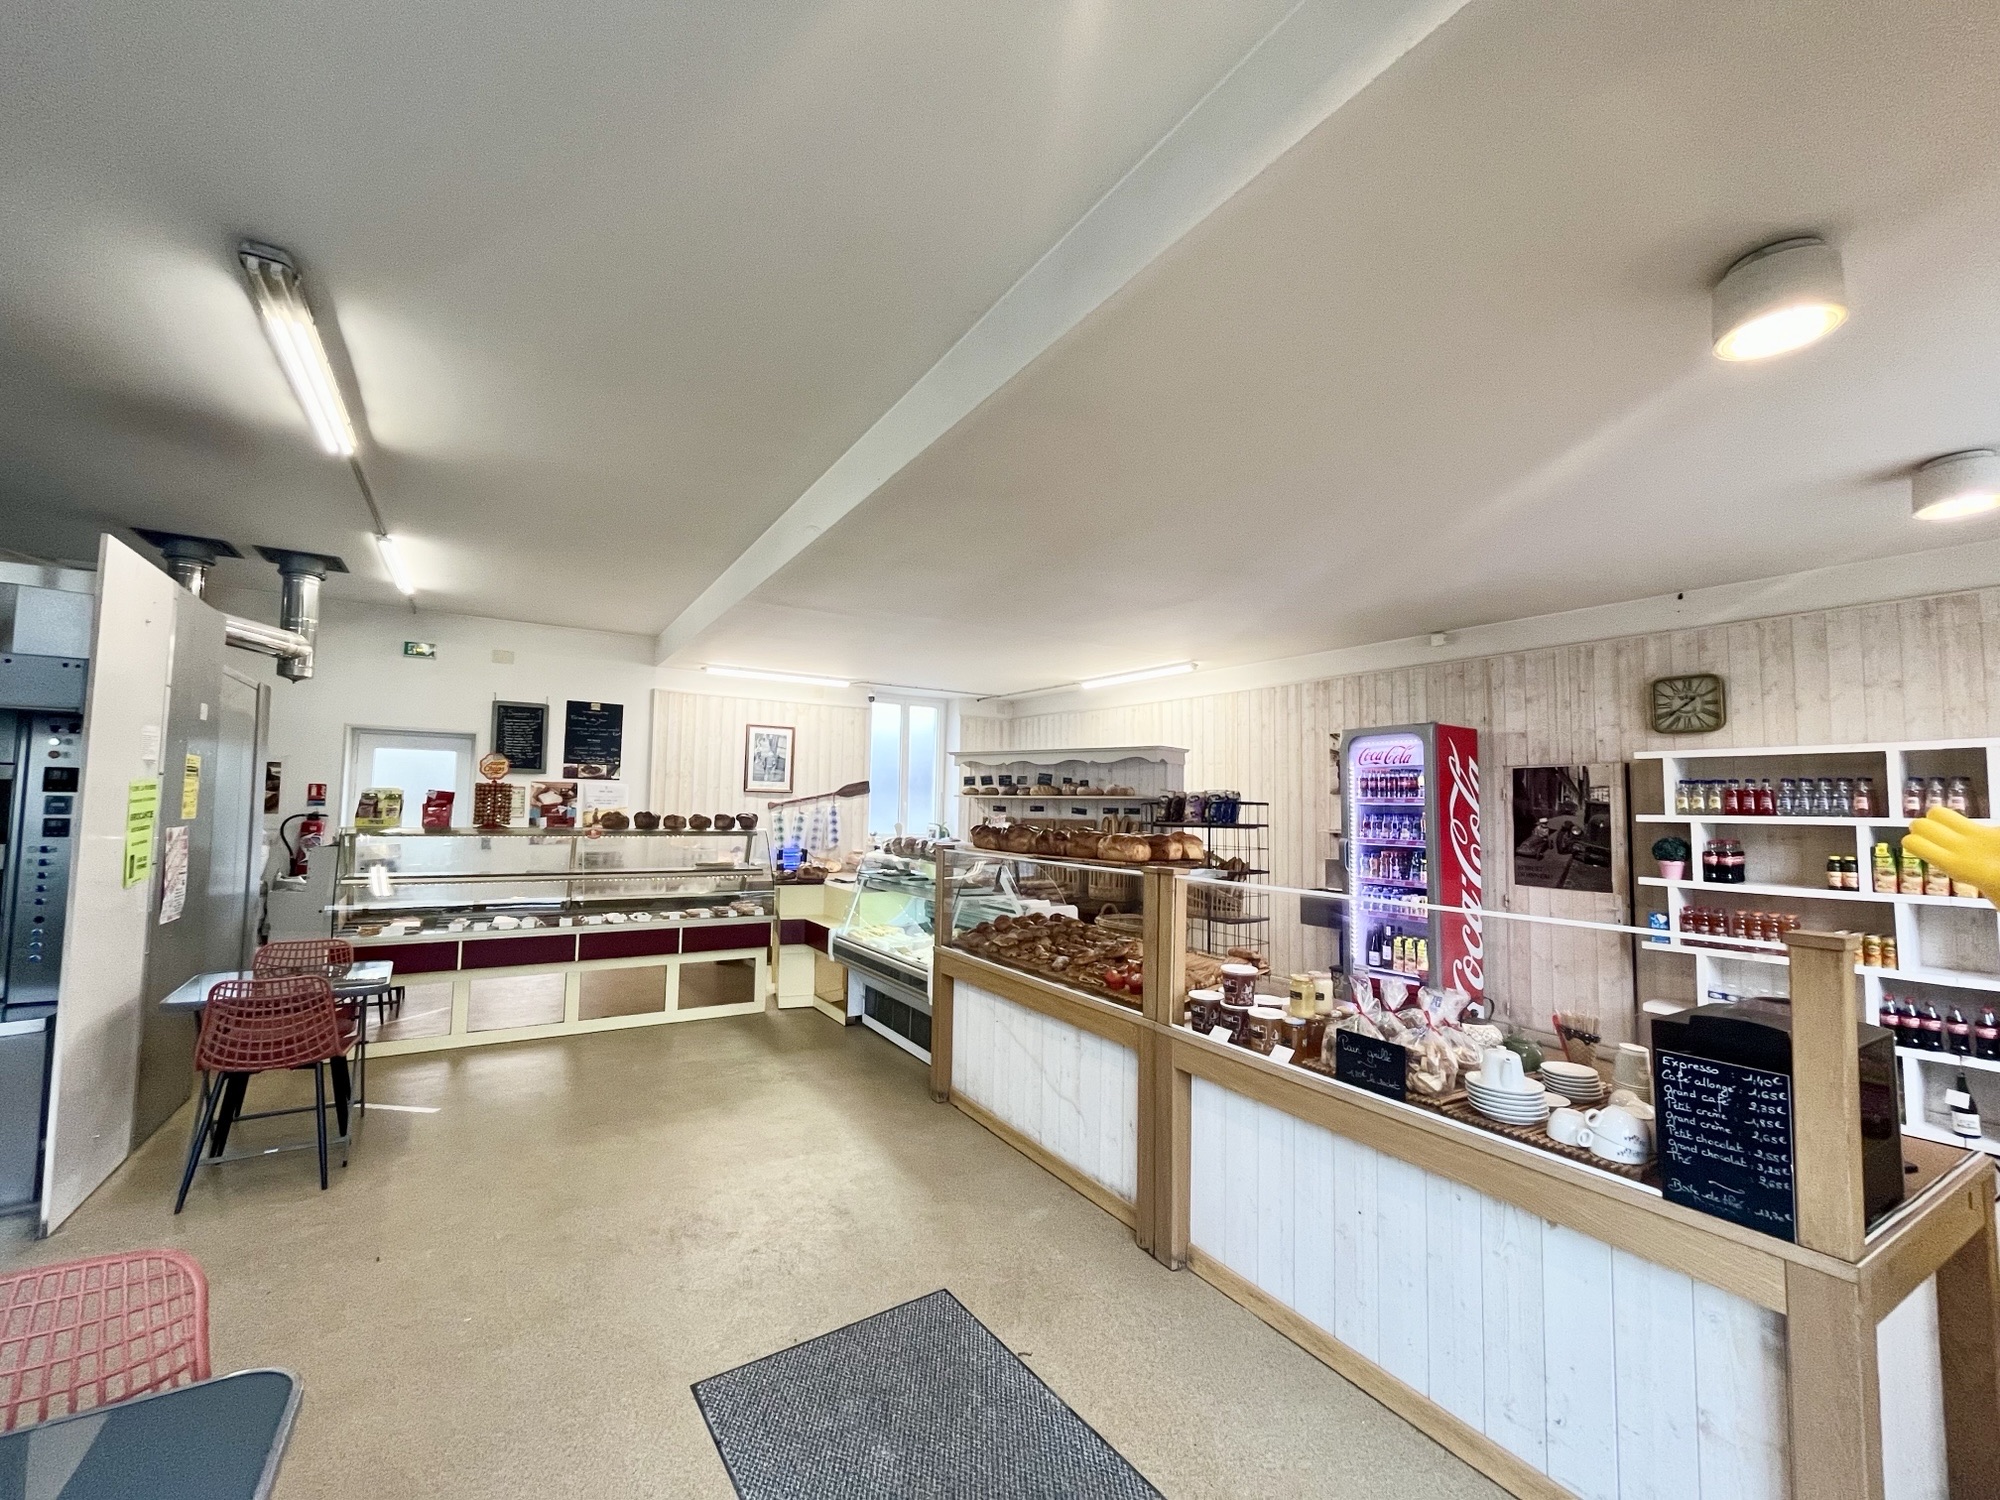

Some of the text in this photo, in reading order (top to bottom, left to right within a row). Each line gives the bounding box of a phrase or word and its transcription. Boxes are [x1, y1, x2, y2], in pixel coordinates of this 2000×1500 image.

[1662, 1056, 1719, 1075] Expresso
[1662, 1069, 1787, 1100] Café allongé 1,65€
[1664, 1097, 1784, 1129] Petit crème 1,85€
[1701, 1093, 1731, 1112] café
[1748, 1102, 1786, 1115] 2,35€
[1666, 1125, 1693, 1140] Petit
[1696, 1134, 1744, 1153] chocolat
[1700, 1120, 1732, 1134] crème
[1752, 1131, 1787, 1144] 2,65€
[1667, 1151, 1692, 1165] Thé
[1701, 1149, 1748, 1167] chocolat
